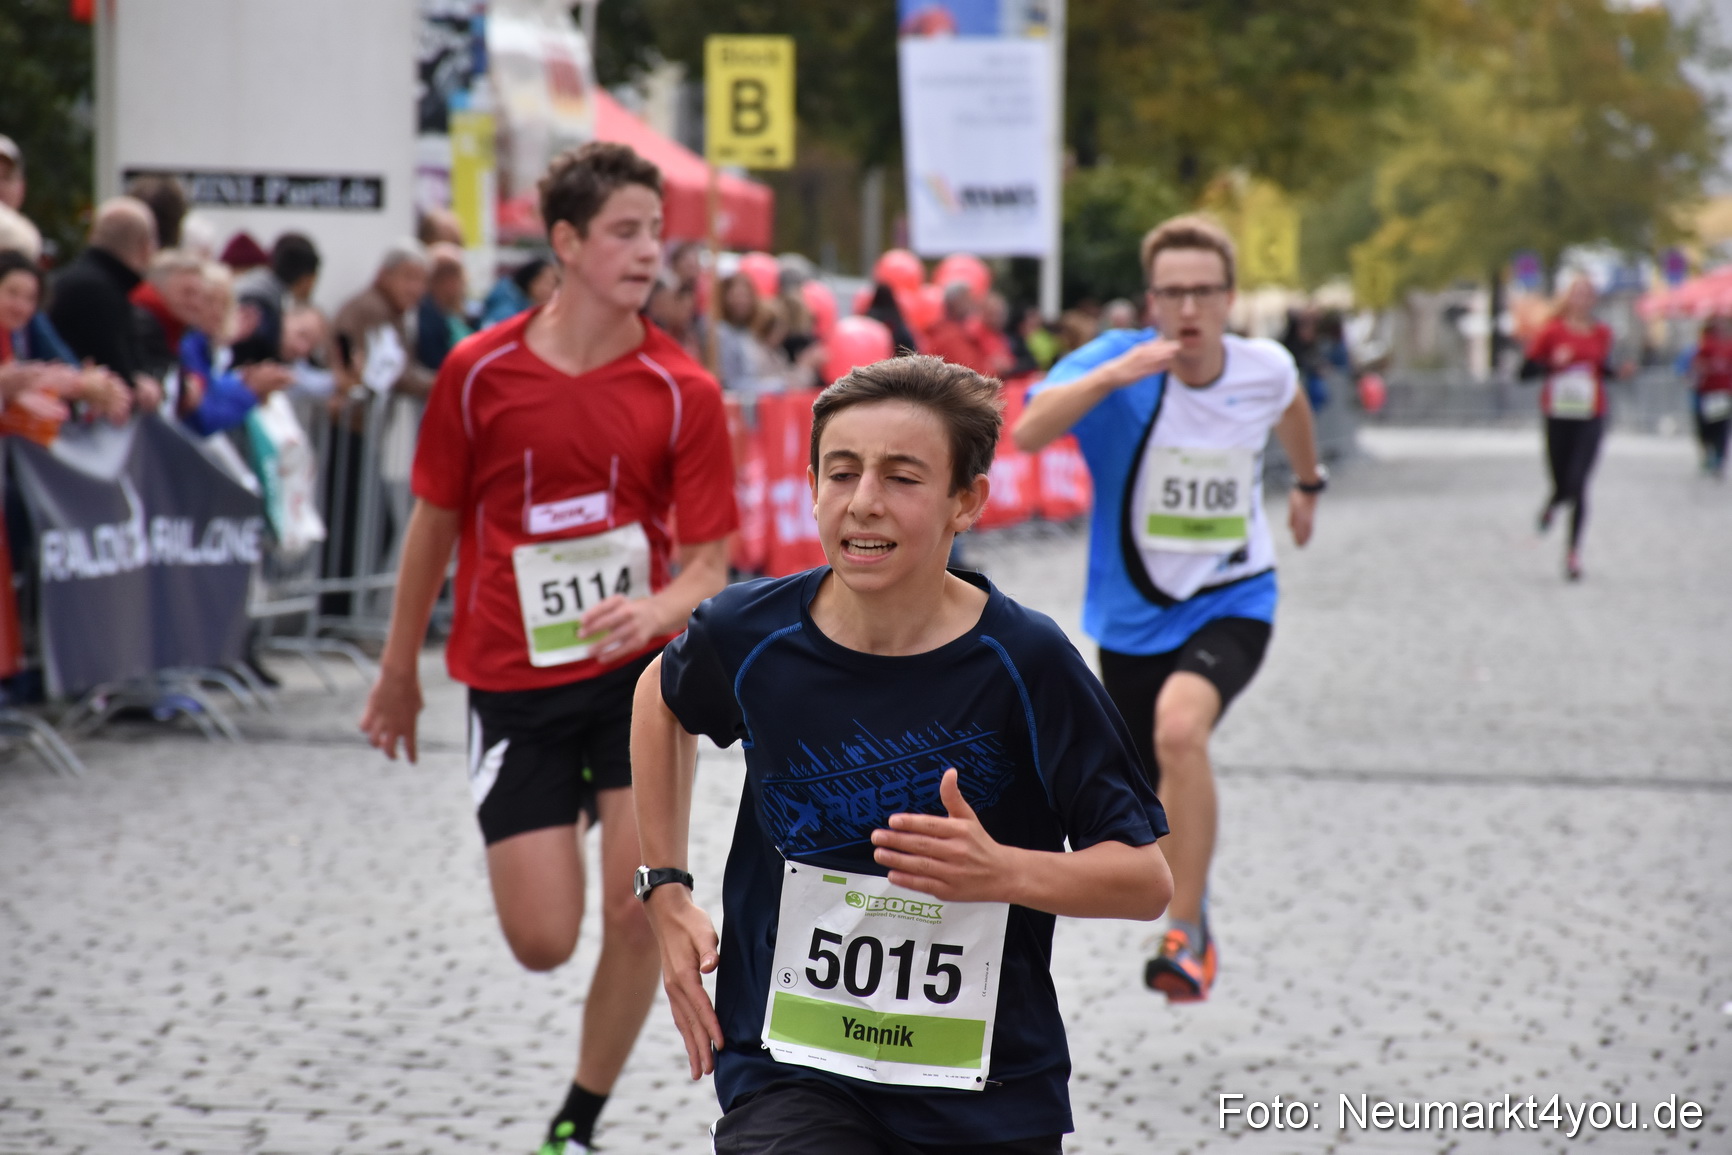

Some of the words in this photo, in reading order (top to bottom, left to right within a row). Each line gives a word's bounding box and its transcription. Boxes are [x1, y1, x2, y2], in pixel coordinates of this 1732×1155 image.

[731, 78, 770, 137] B
[541, 566, 632, 617] 5114
[866, 895, 944, 919] BOCK
[916, 916, 942, 925] concepts
[783, 973, 791, 984] S
[805, 928, 964, 1004] 5015
[842, 1016, 914, 1048] Yannik
